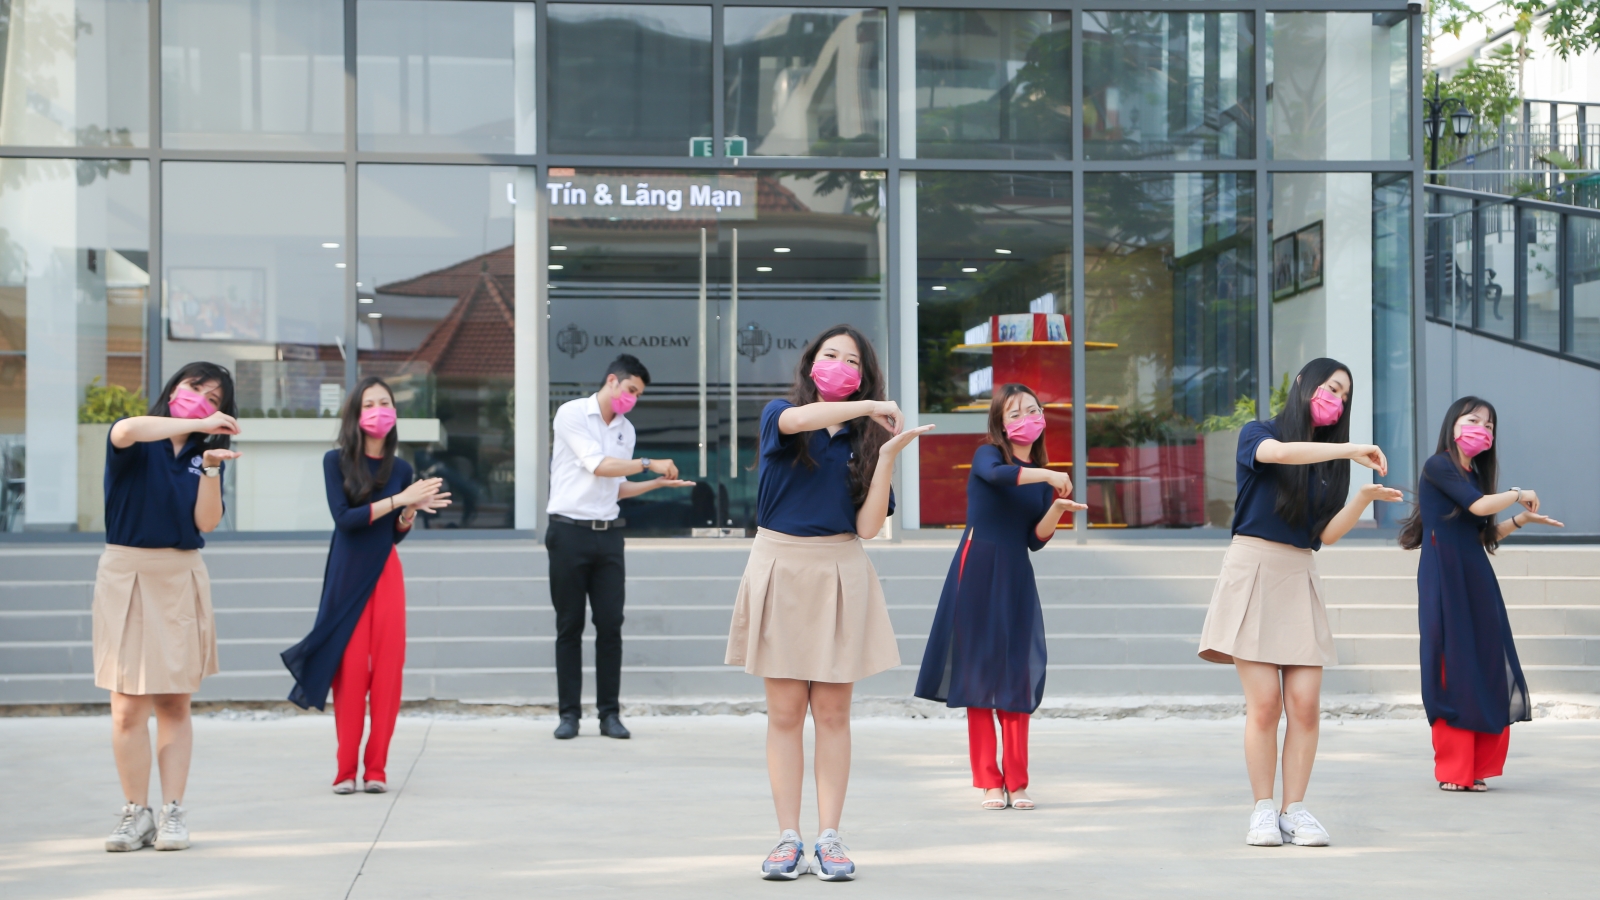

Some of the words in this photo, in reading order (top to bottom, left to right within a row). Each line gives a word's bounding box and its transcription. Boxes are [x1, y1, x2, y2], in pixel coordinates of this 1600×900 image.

[703, 141, 733, 158] ET
[546, 182, 587, 205] Tín
[593, 183, 613, 205] &
[620, 182, 683, 211] Lãng
[689, 184, 742, 212] Mạn
[593, 335, 615, 347] UK
[618, 335, 692, 347] ACADEMY
[776, 338, 798, 350] UK
